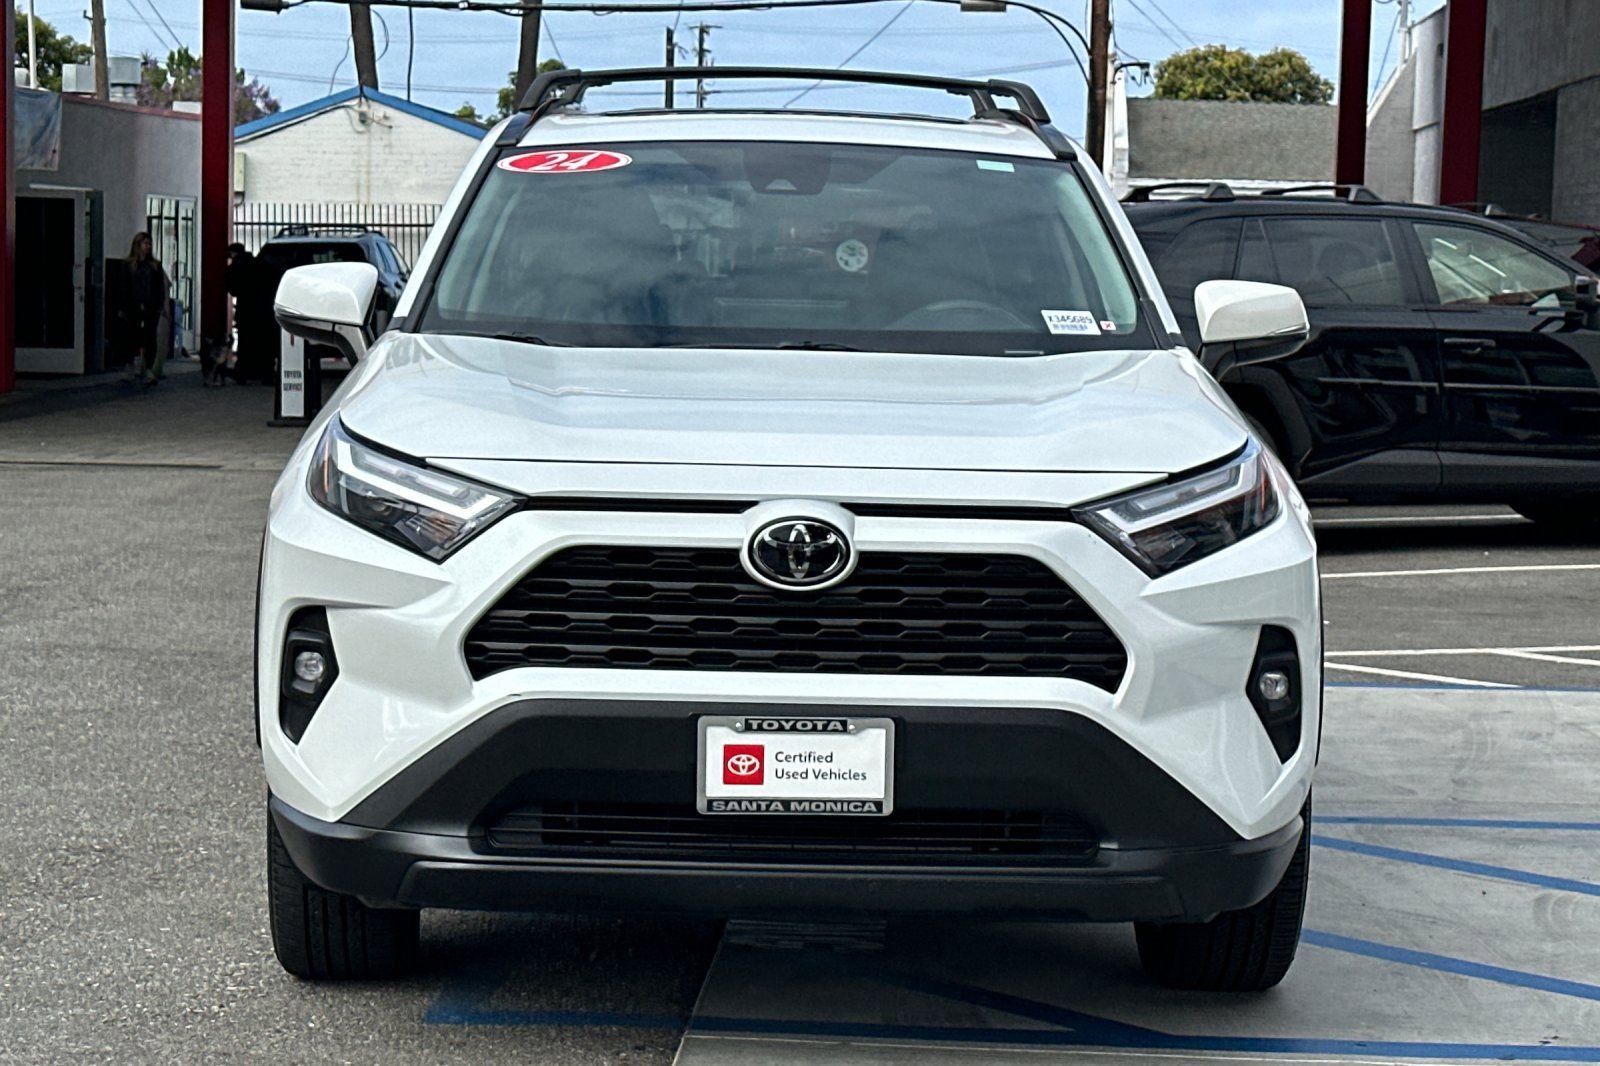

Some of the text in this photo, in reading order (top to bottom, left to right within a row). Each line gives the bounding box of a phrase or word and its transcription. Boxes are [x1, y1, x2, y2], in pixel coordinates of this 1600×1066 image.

[528, 152, 602, 171] 24
[284, 370, 302, 379] TOYOTA
[748, 719, 844, 731] TOYOTA
[774, 751, 834, 763] Certified
[774, 768, 867, 781] Used Vehicles
[712, 800, 878, 813] SANTA MONICA
